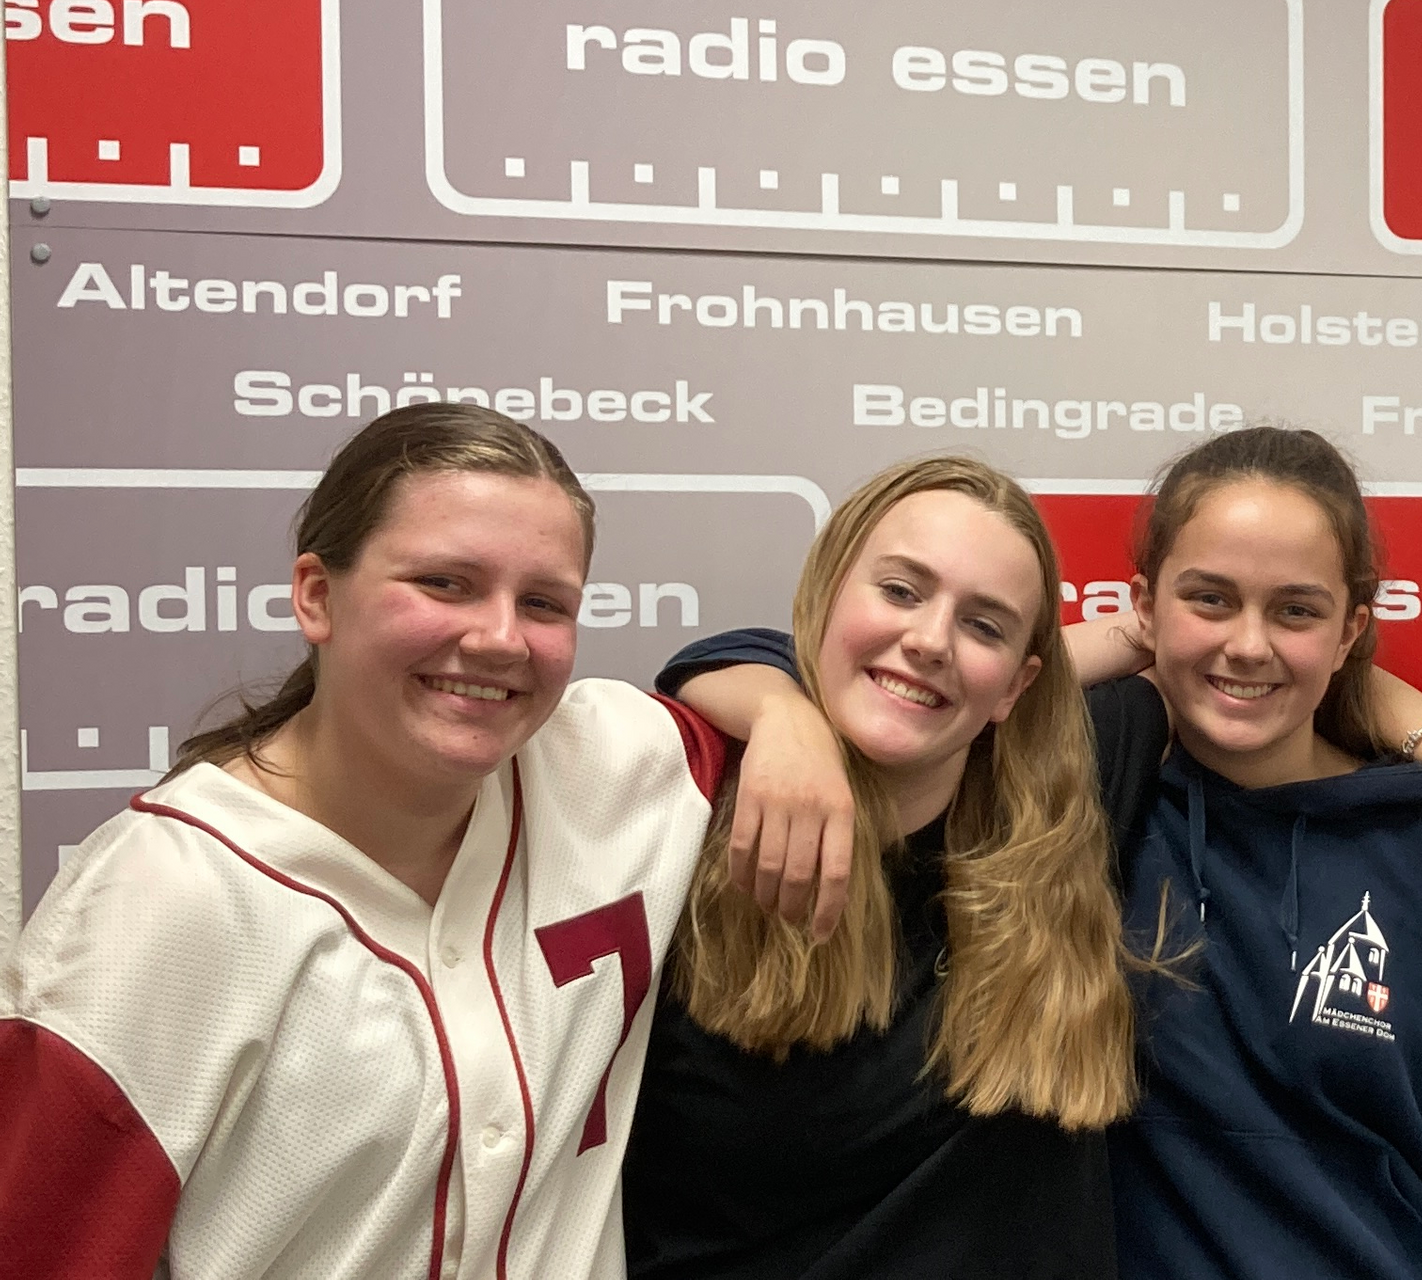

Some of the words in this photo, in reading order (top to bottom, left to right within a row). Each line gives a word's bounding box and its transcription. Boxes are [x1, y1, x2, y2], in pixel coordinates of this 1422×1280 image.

[566, 18, 846, 86] radio
[892, 45, 1187, 107] essen
[57, 263, 462, 319] Altendorf
[607, 280, 1083, 338] Frohnhausen
[234, 370, 715, 423] Schönebeck
[853, 384, 1244, 439] Bedingrade
[534, 890, 652, 1157] 7
